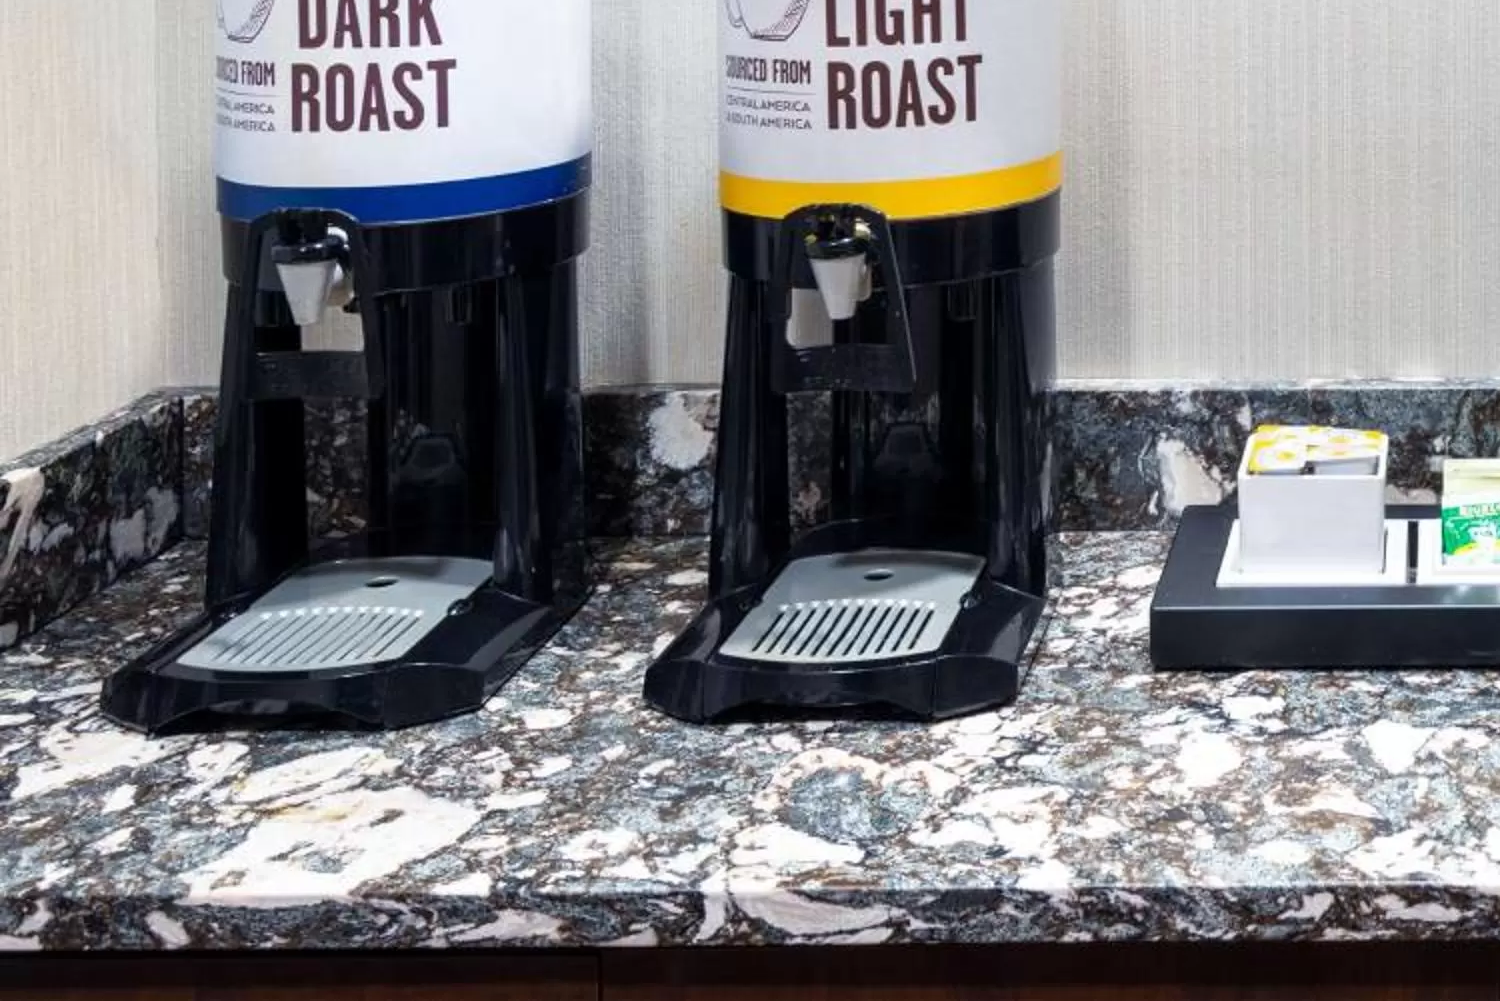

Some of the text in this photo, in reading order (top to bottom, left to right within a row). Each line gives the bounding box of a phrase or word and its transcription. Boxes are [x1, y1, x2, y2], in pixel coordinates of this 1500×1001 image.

[241, 60, 275, 87] FROM
[773, 58, 811, 85] FROM
[291, 59, 457, 133] ROAST
[760, 99, 811, 112] AMERICA
[827, 55, 983, 130] ROAST
[760, 117, 812, 130] AMERICA
